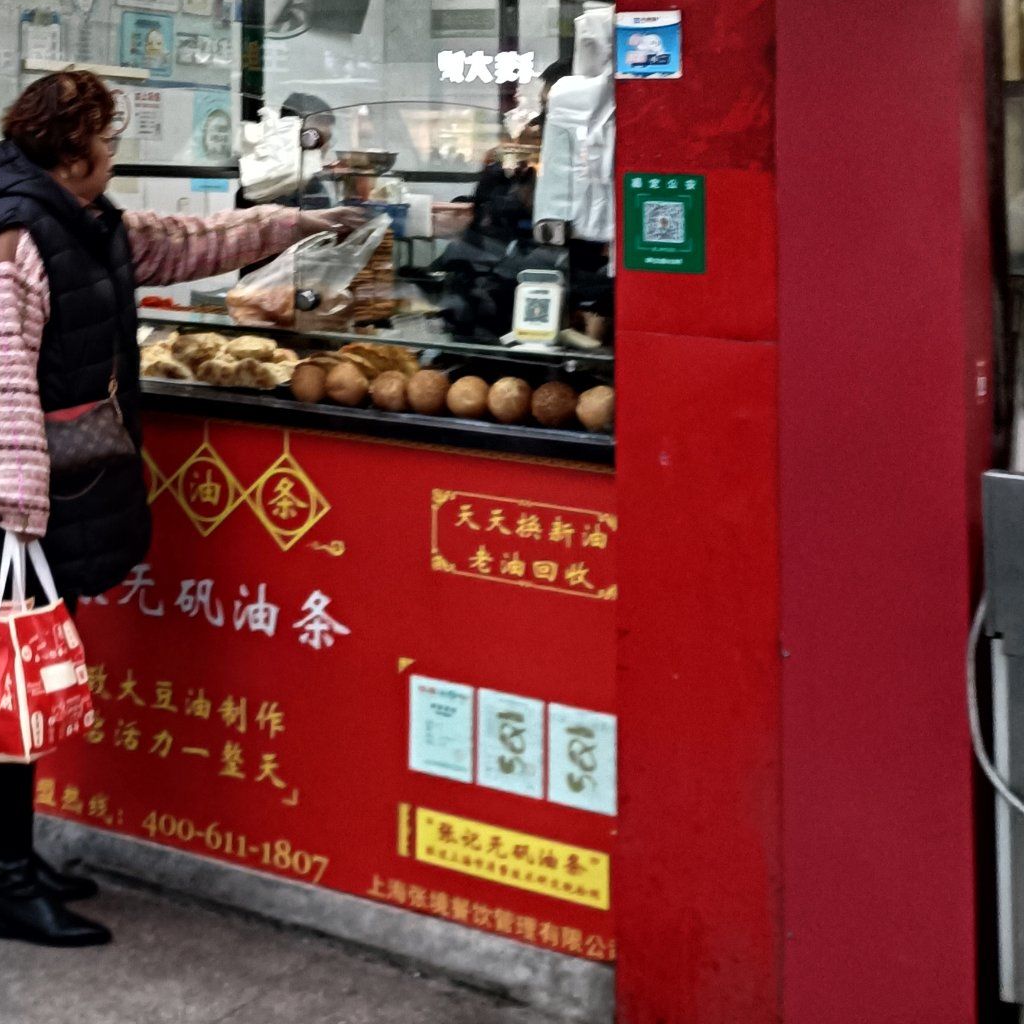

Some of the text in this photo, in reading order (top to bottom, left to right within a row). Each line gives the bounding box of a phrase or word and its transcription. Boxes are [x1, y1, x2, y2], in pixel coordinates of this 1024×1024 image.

[453, 502, 610, 551] 天天换新油
[468, 545, 595, 590] 老油回收
[79, 564, 351, 649] 无矾油条
[141, 811, 330, 884] 400-611-1807
